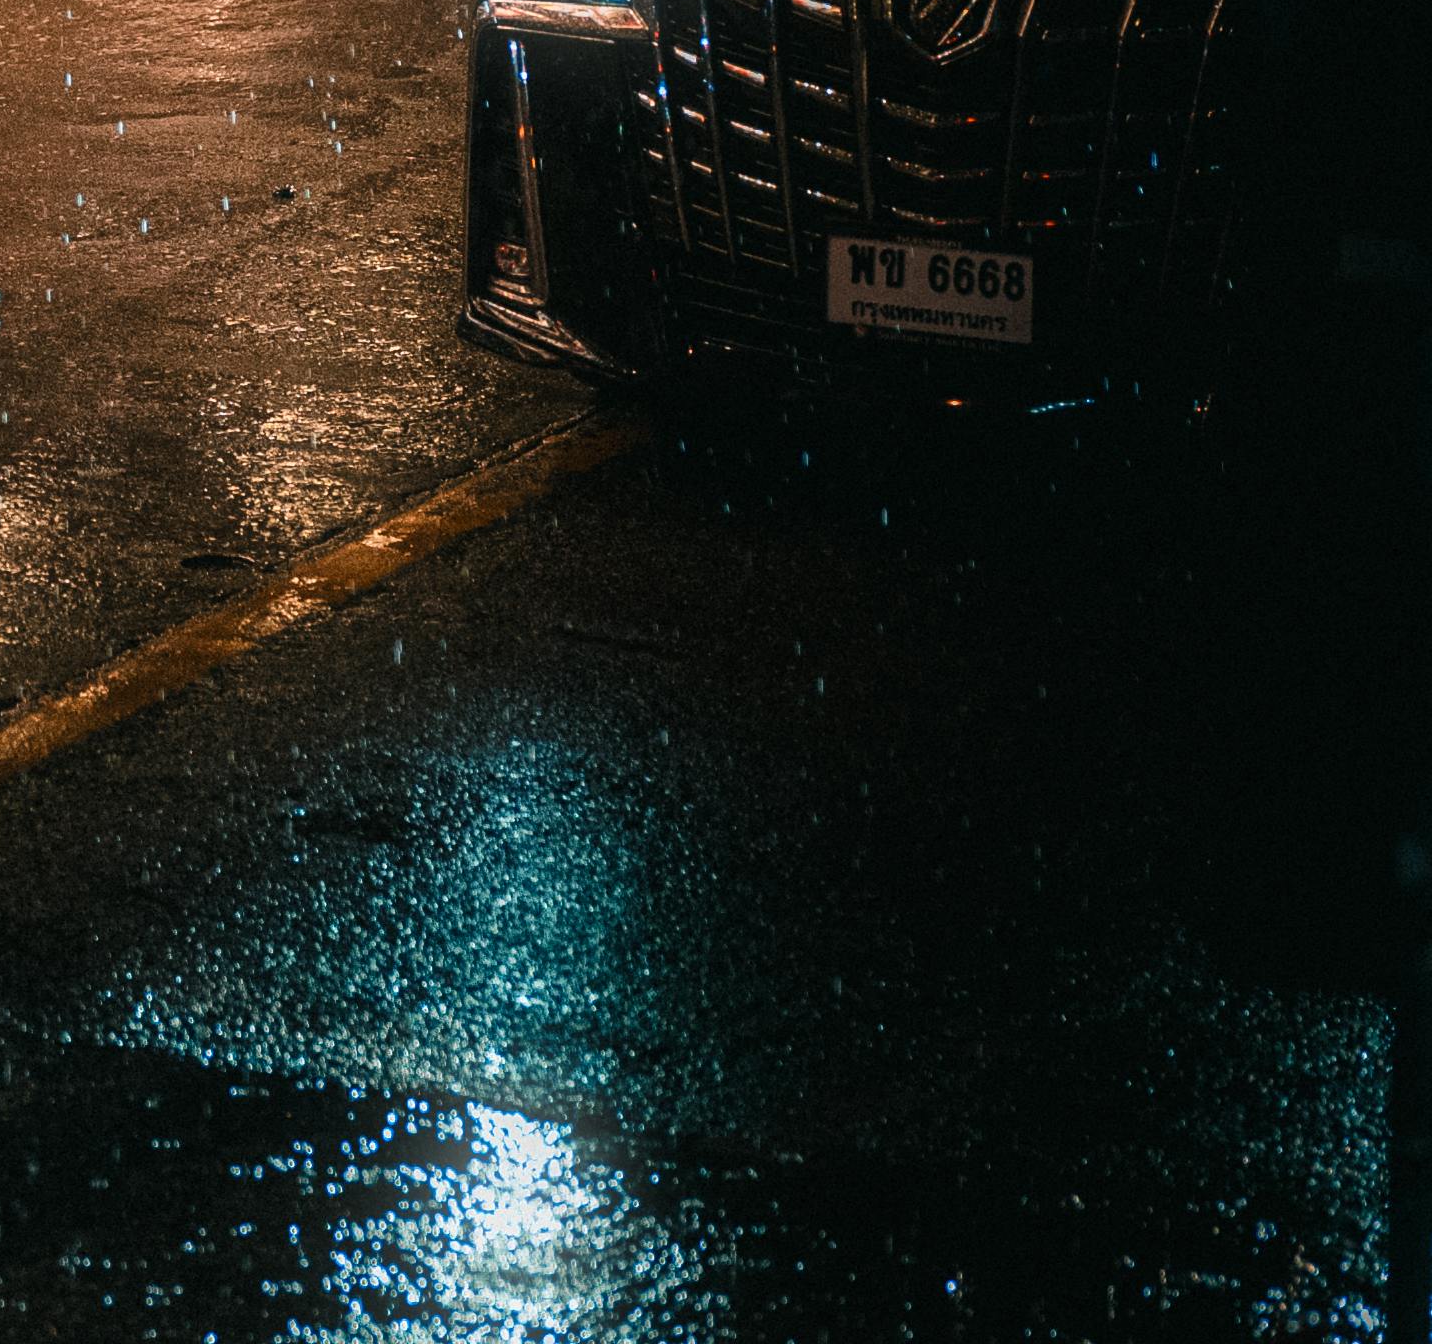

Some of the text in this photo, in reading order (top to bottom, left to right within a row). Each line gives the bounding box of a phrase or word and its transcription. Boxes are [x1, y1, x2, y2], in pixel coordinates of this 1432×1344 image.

[928, 253, 1025, 302] 6668
[851, 300, 1008, 331] กรุงเทพมหานคร
